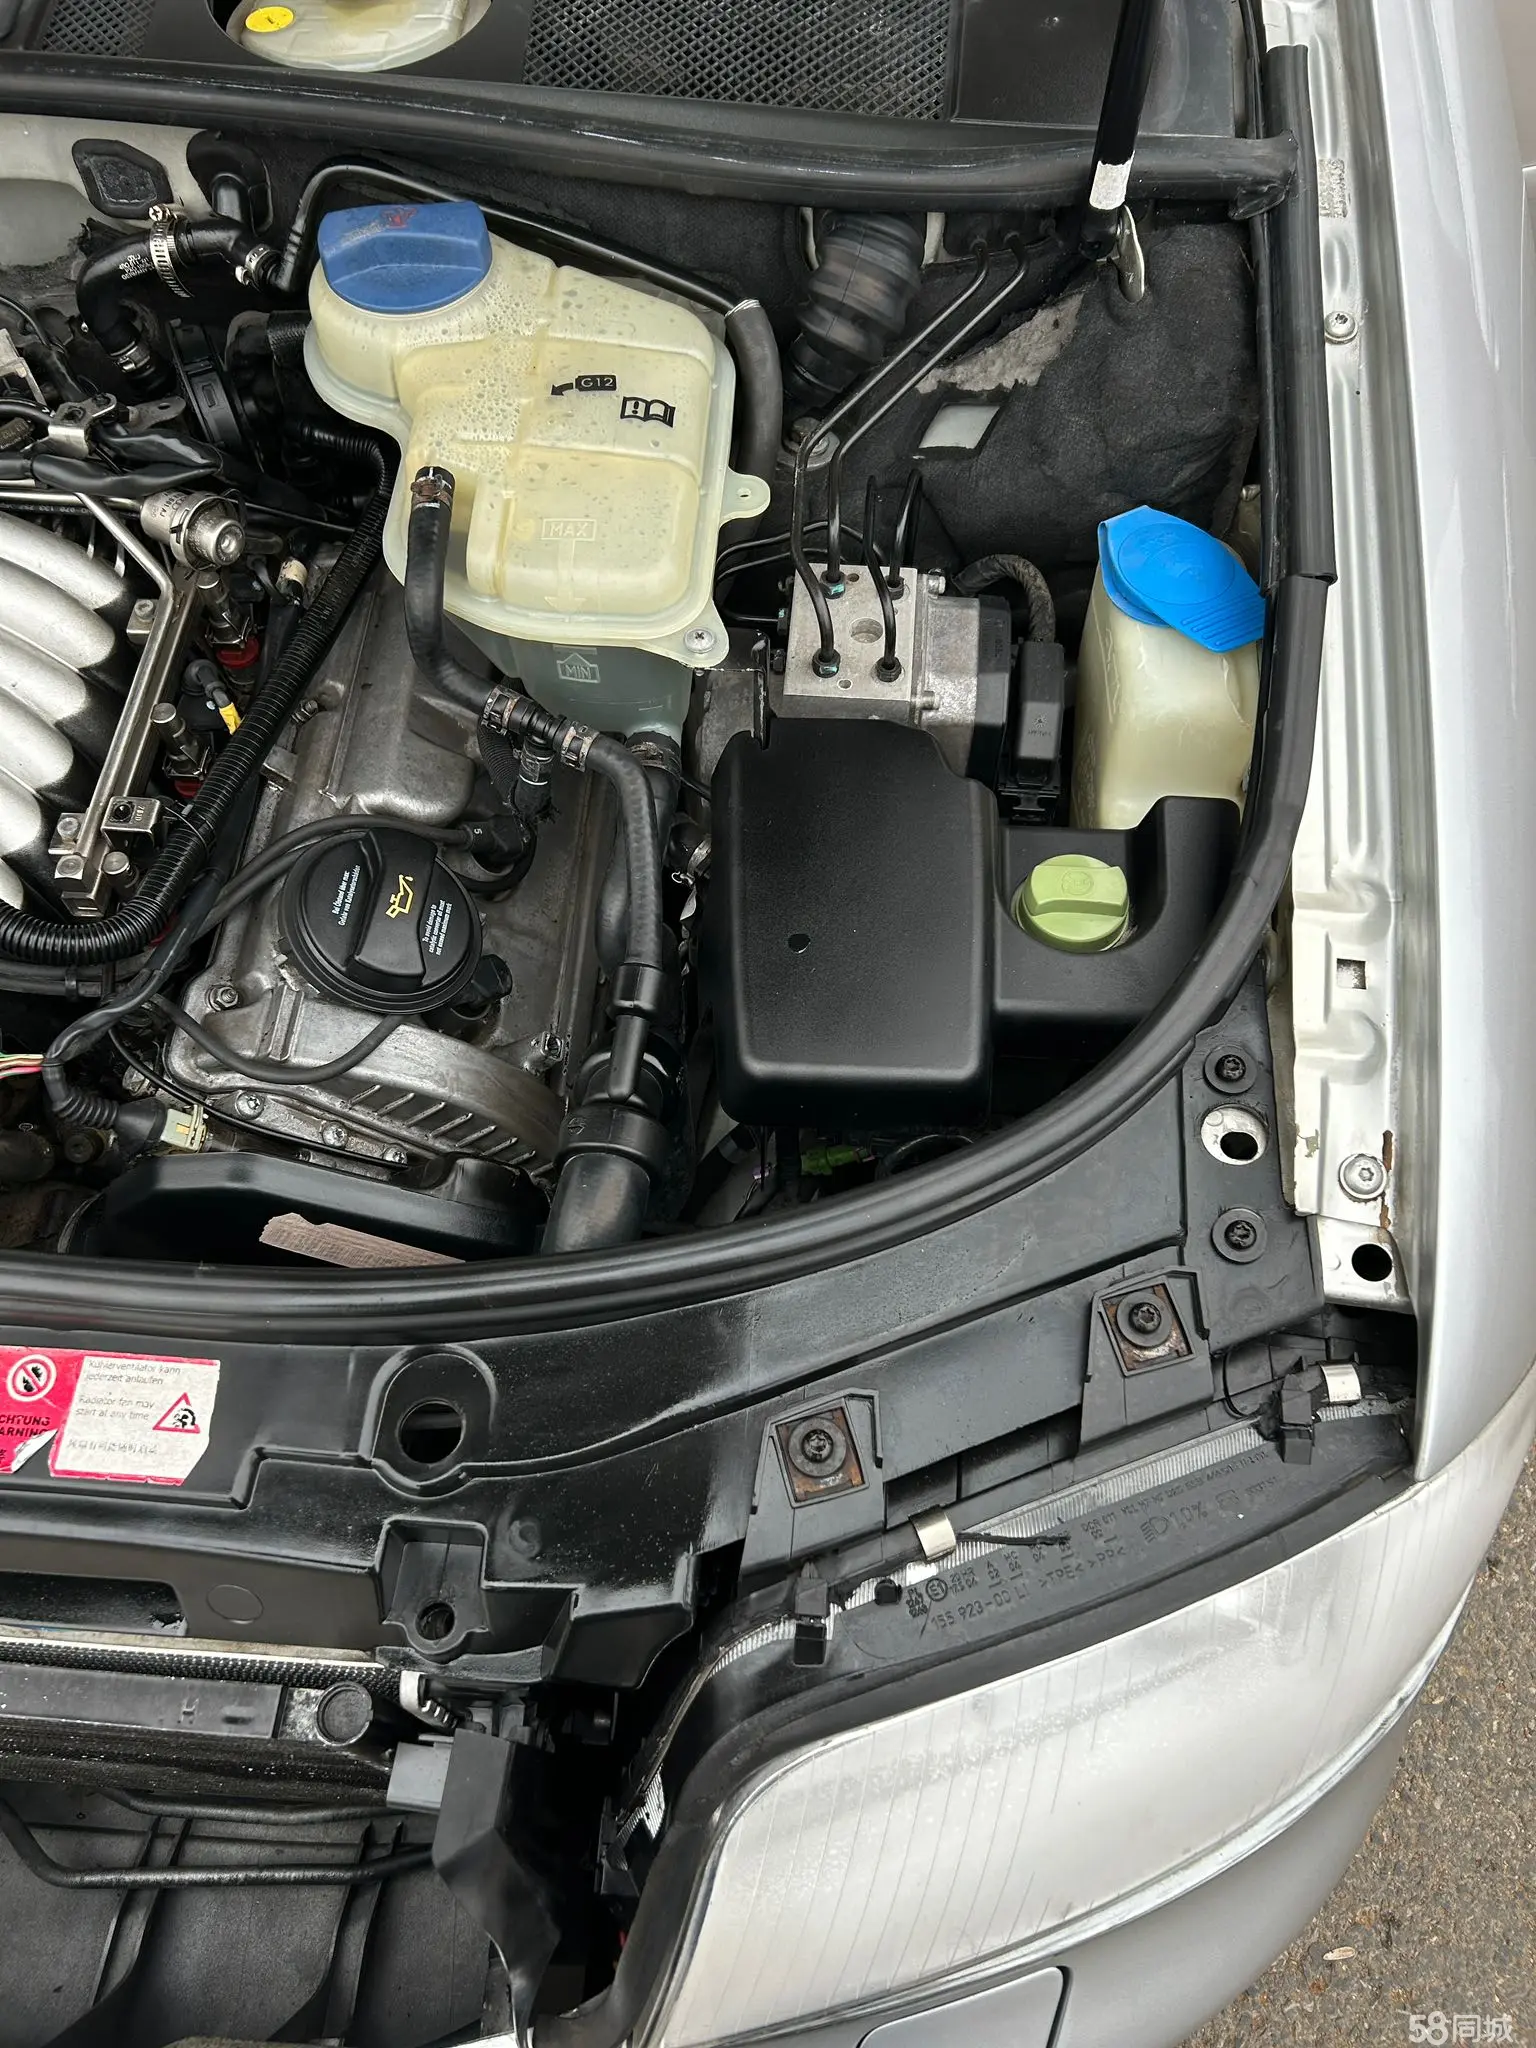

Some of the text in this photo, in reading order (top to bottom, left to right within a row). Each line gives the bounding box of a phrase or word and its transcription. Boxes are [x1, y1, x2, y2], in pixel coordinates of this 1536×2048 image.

[581, 376, 614, 389] G12
[550, 522, 589, 537] MAX
[564, 664, 591, 679] MIN
